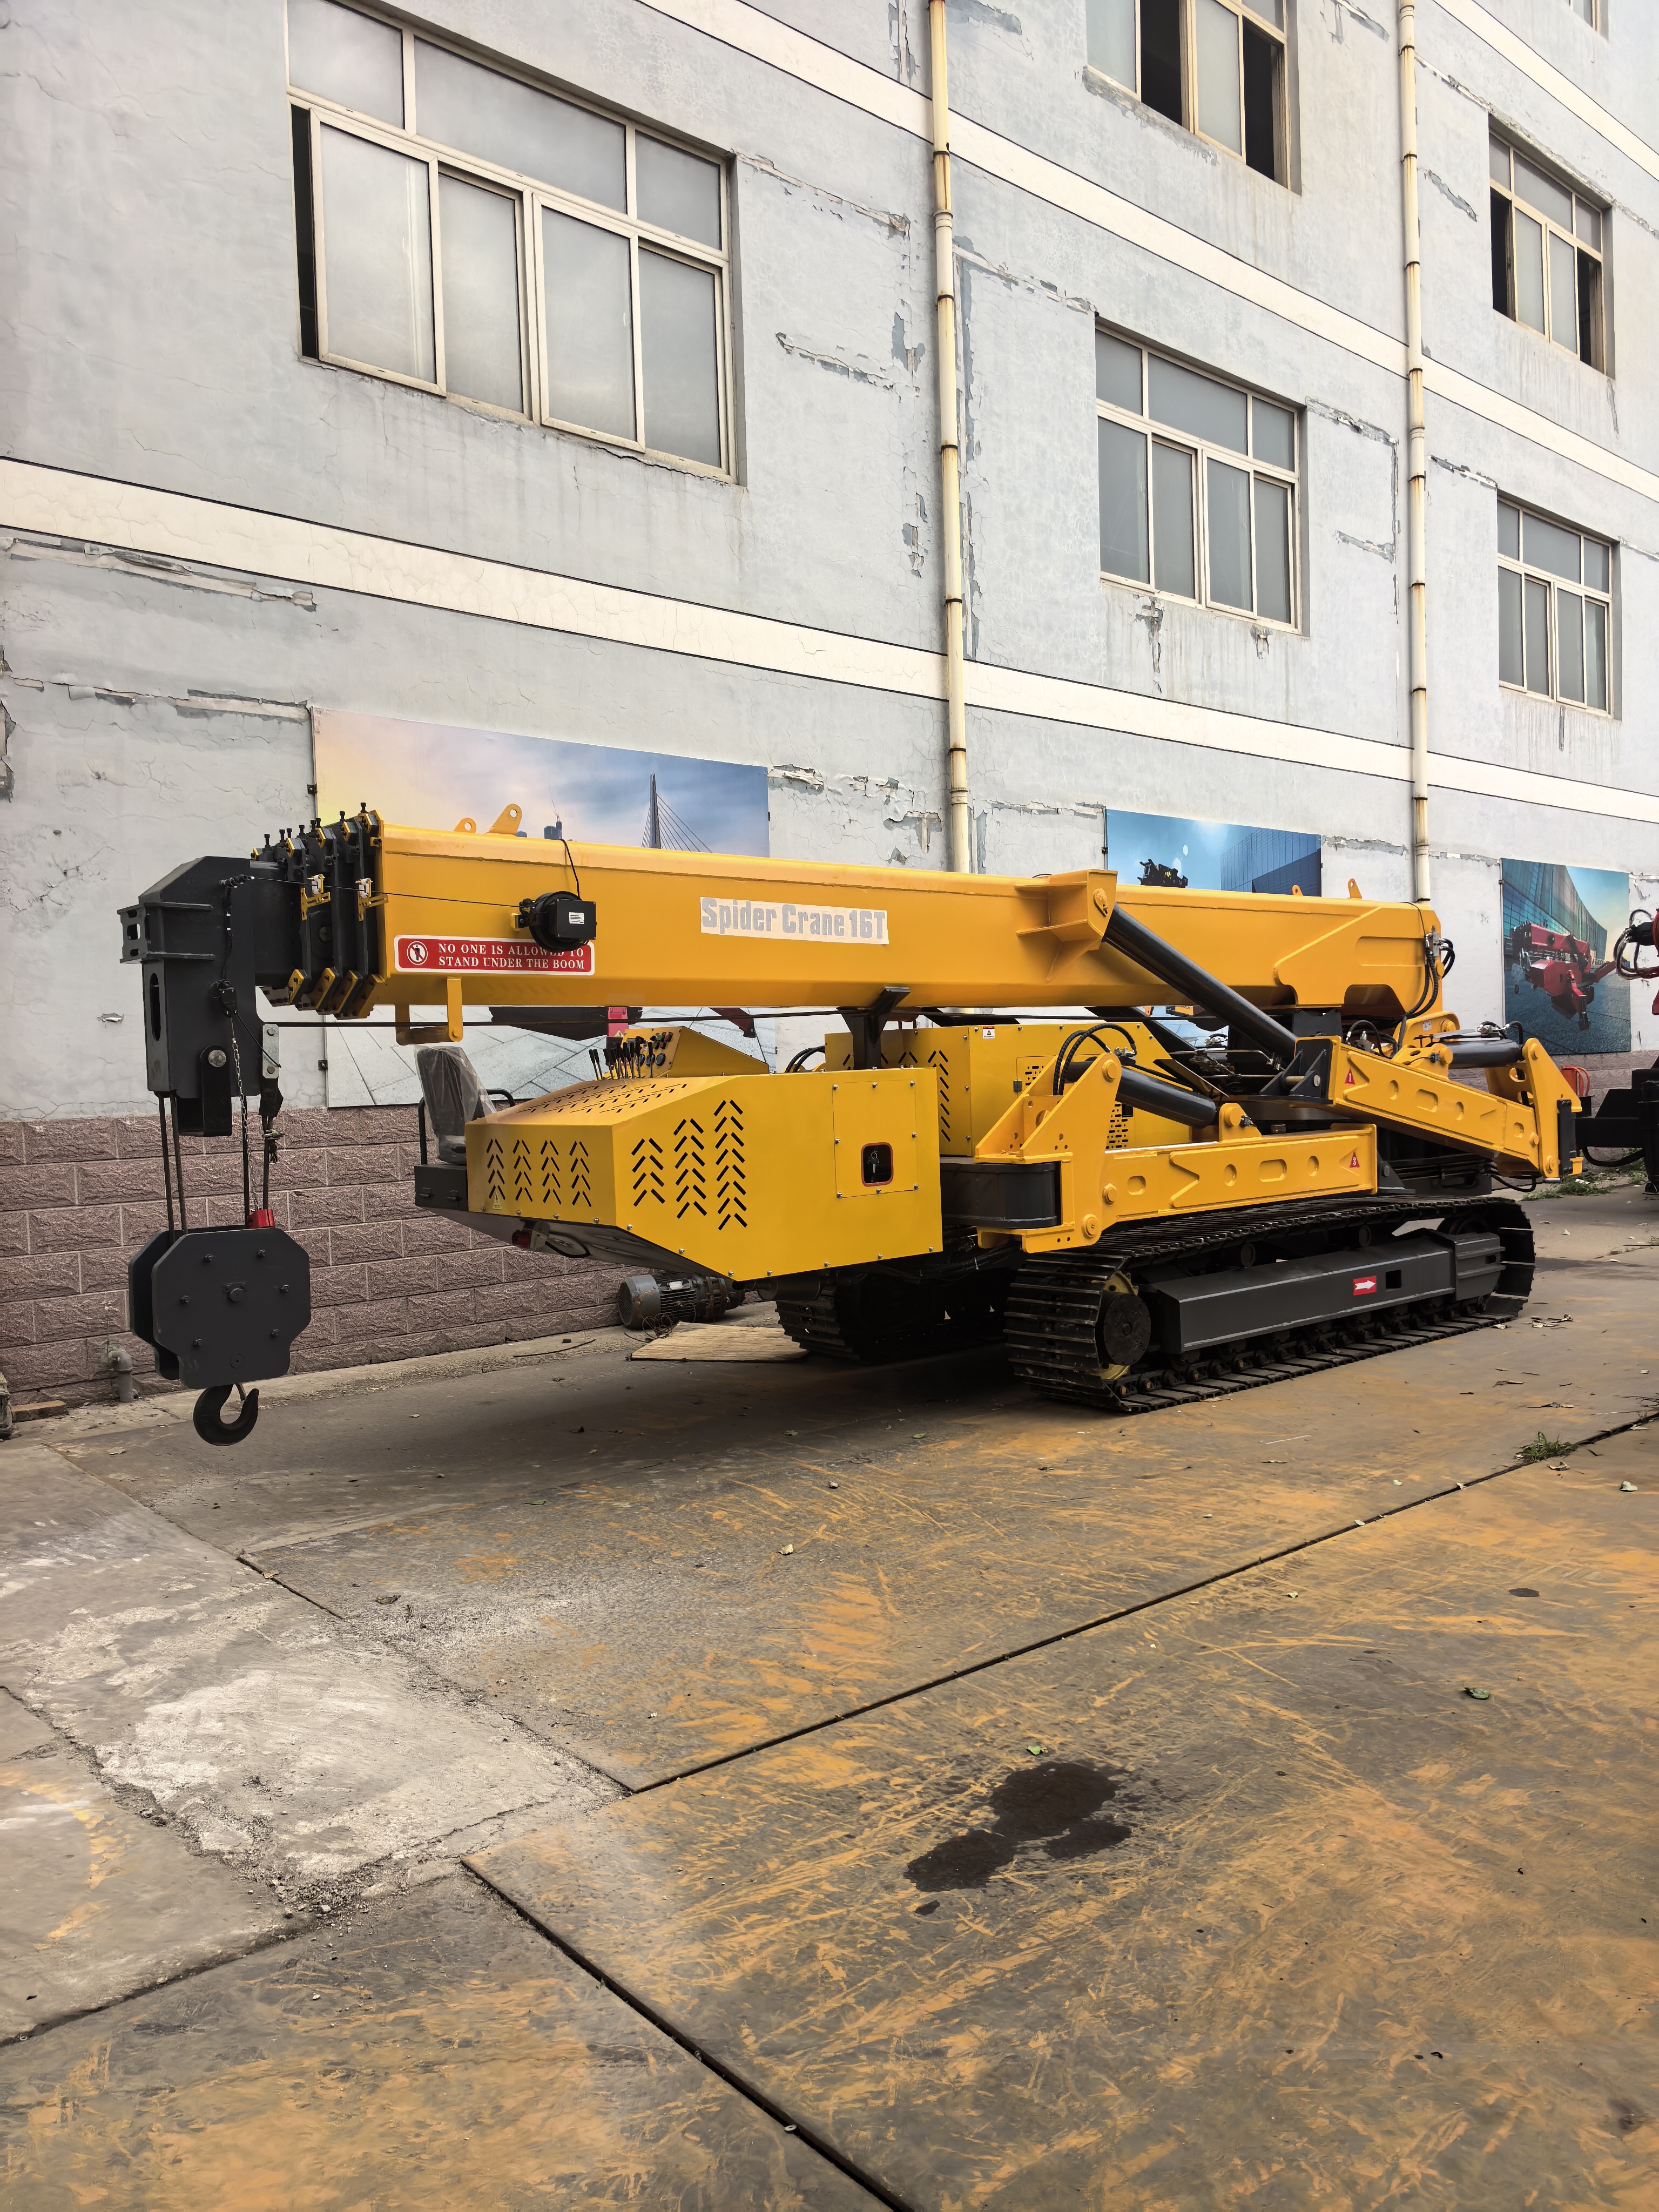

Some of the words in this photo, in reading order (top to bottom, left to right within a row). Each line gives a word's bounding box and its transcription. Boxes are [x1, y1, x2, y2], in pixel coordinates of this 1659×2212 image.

[702, 898, 777, 934] Spider
[783, 904, 844, 936] Crane
[849, 910, 885, 939] 16T
[439, 943, 456, 953] NO
[461, 945, 486, 954] ONE
[491, 945, 503, 955] IS
[439, 956, 479, 966] STAND
[483, 957, 522, 967] UNDER
[527, 959, 549, 968] THE
[552, 959, 584, 969] BOOM
[1348, 1073, 1352, 1082] 1
[1352, 1157, 1356, 1166] 3
